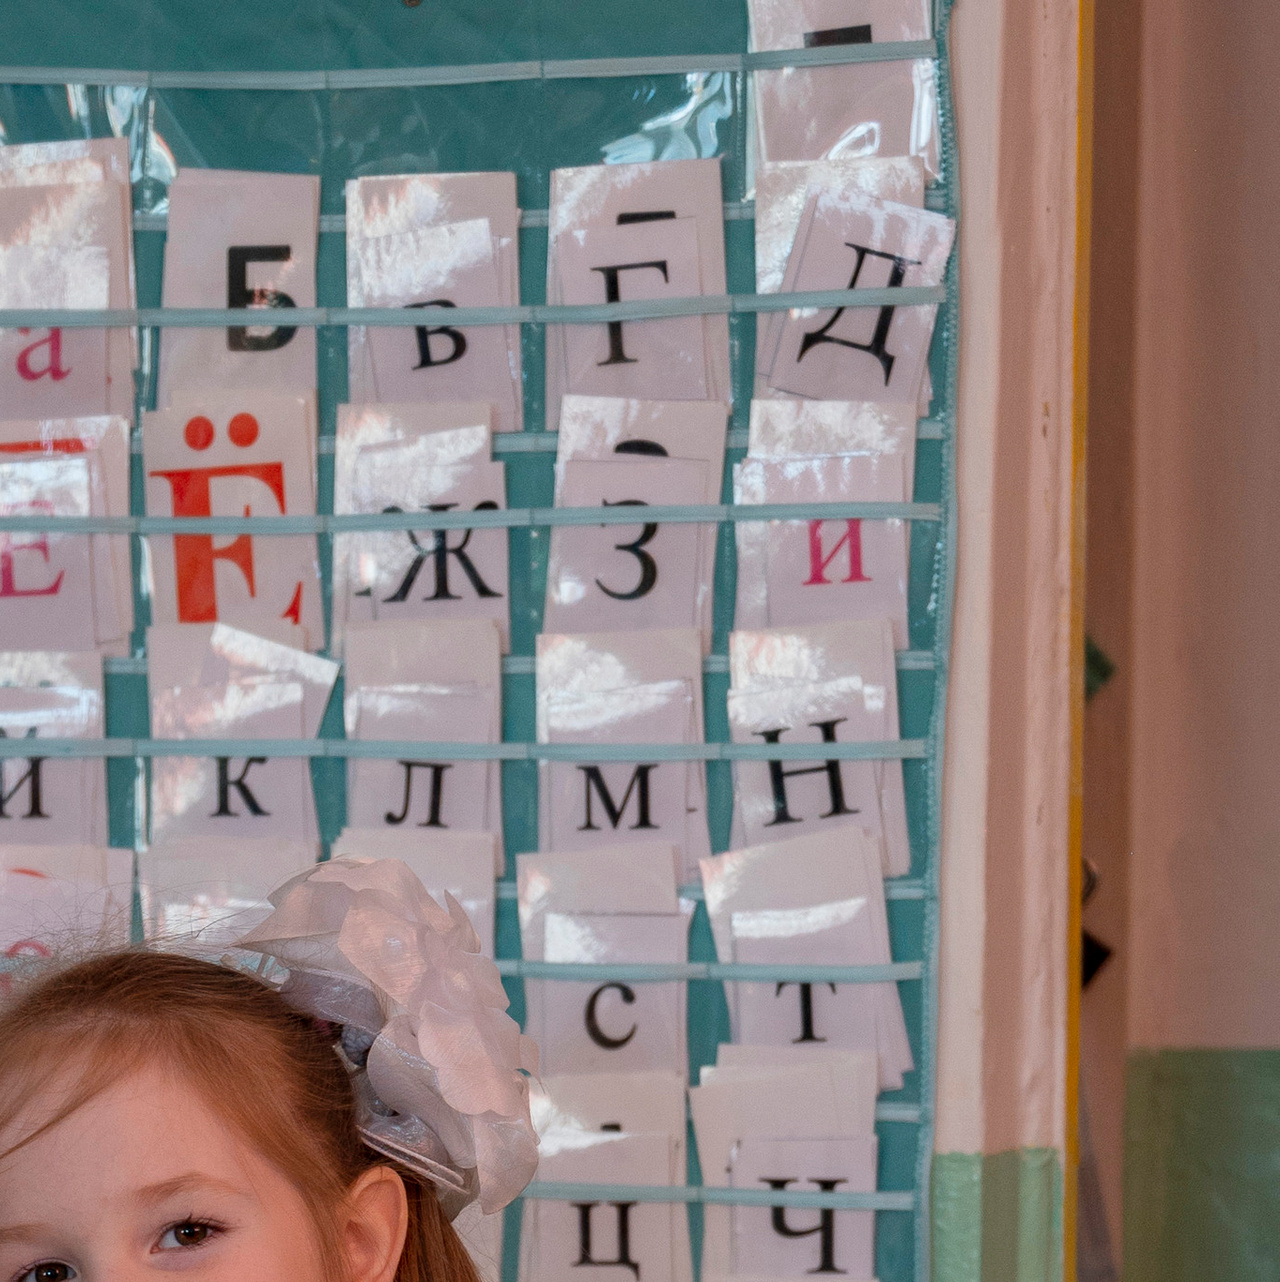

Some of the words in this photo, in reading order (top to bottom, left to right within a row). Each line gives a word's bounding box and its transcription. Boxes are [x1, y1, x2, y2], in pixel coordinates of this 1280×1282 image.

[227, 245, 298, 351] Б
[590, 259, 670, 366] Г
[797, 242, 923, 386] Д
[148, 411, 303, 624] Ё
[382, 499, 504, 602] Ж
[750, 717, 861, 828] Н
[758, 1177, 850, 1275] Ч
